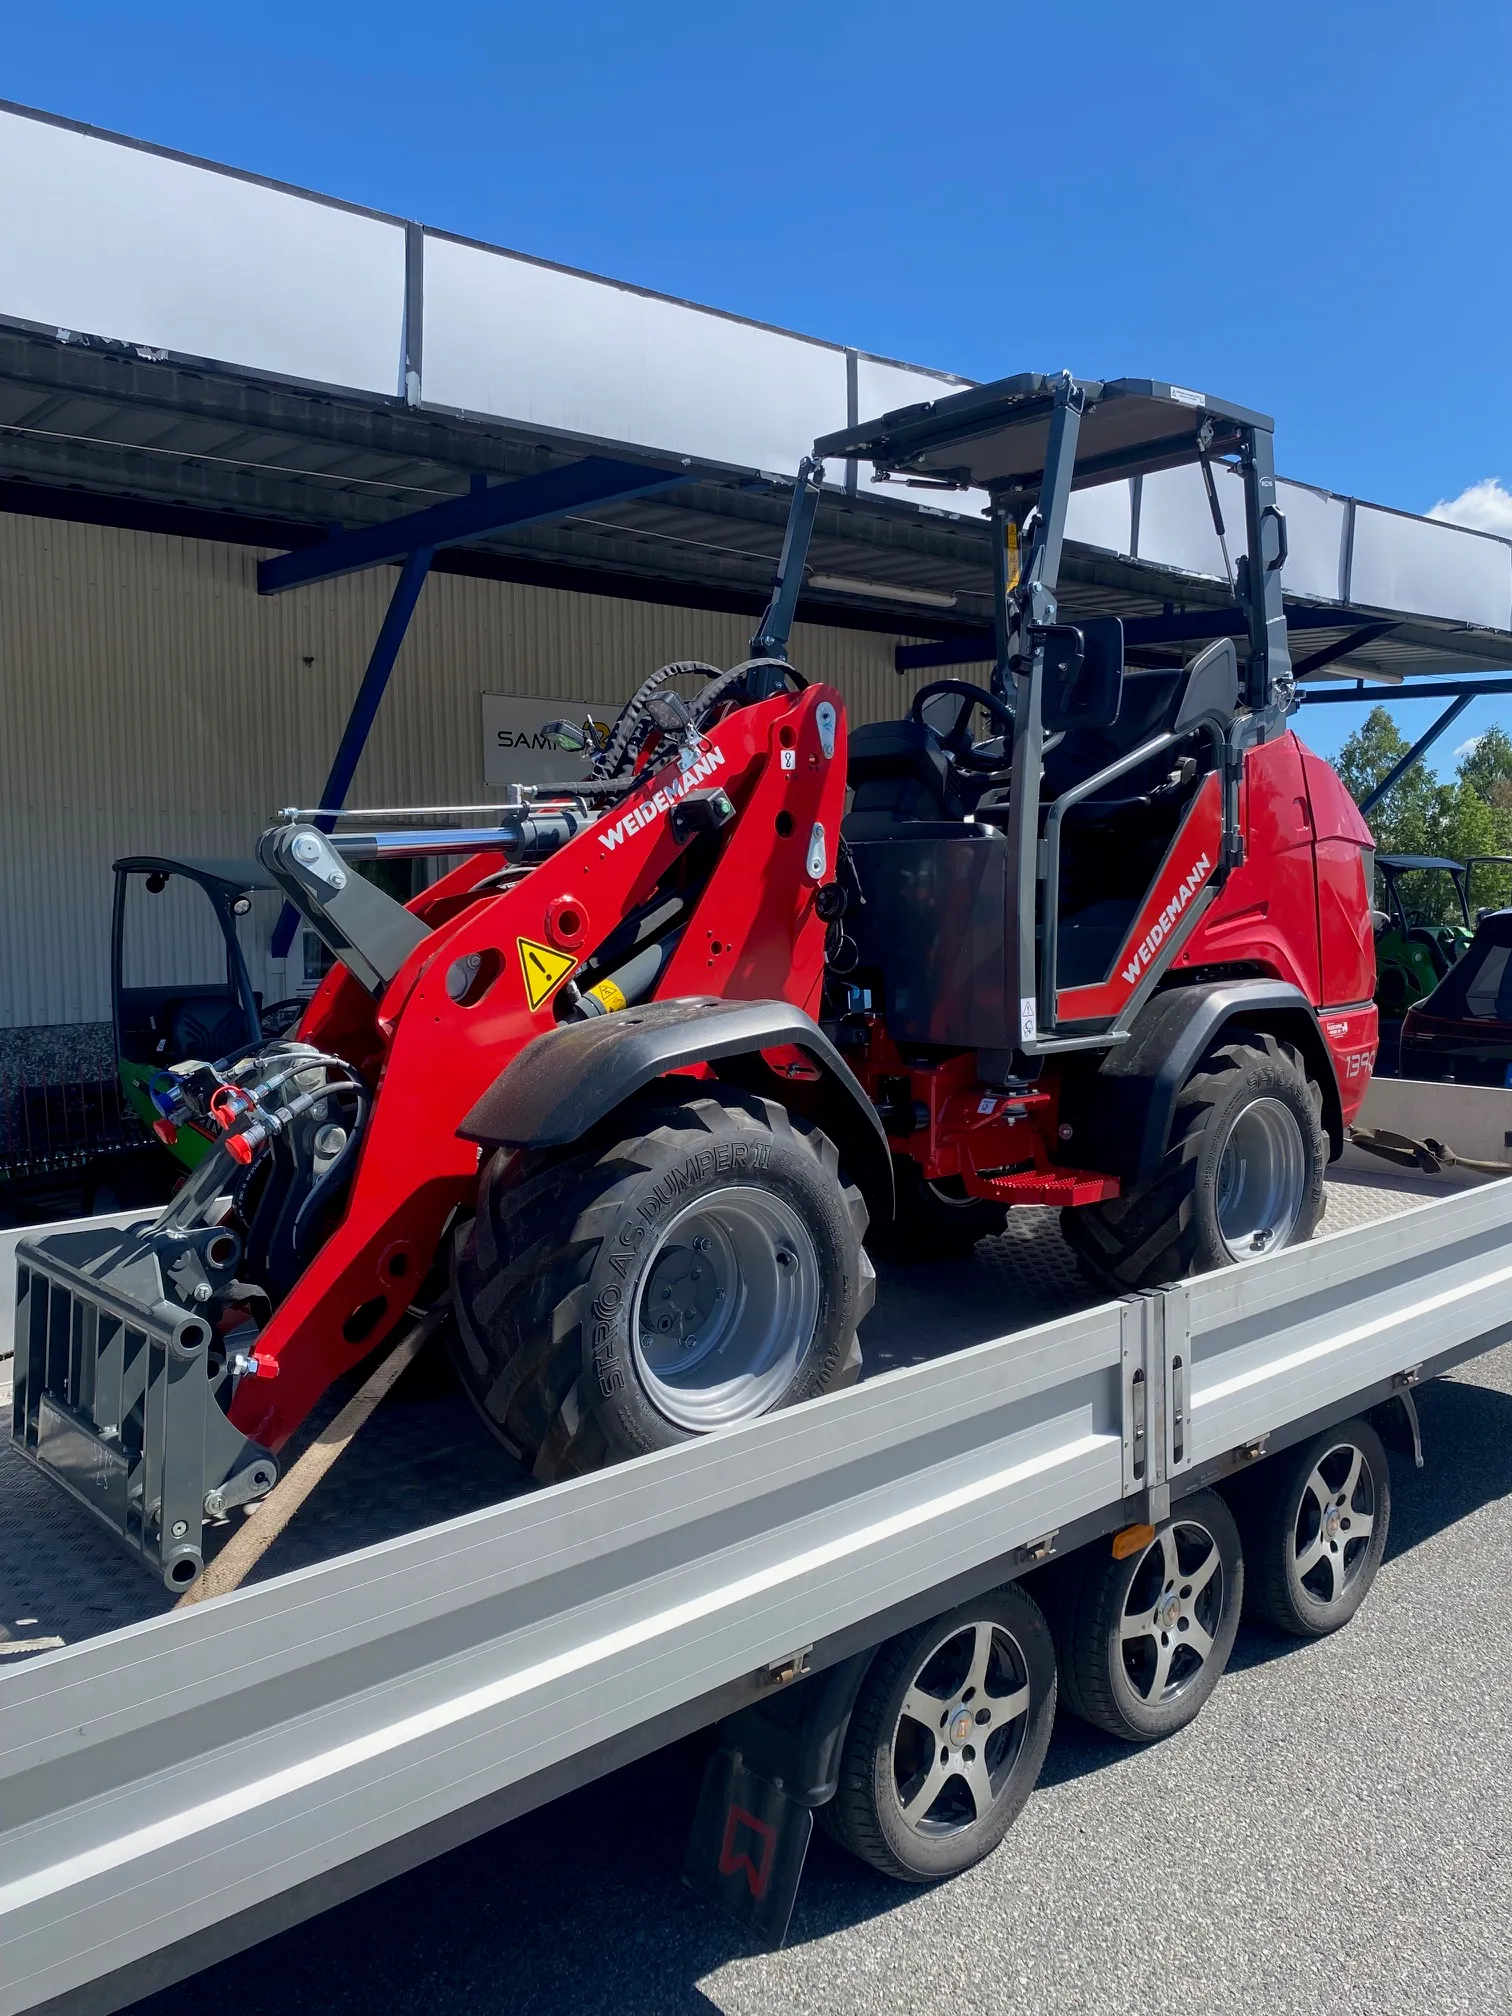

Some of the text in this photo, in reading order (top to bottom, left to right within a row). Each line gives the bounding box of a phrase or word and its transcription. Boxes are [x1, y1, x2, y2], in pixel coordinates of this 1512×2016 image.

[597, 745, 726, 851] WEIDEMANN
[1121, 852, 1211, 985] WEIDEMANN
[608, 1220, 646, 1279] AS
[636, 1142, 750, 1226] DUMPER
